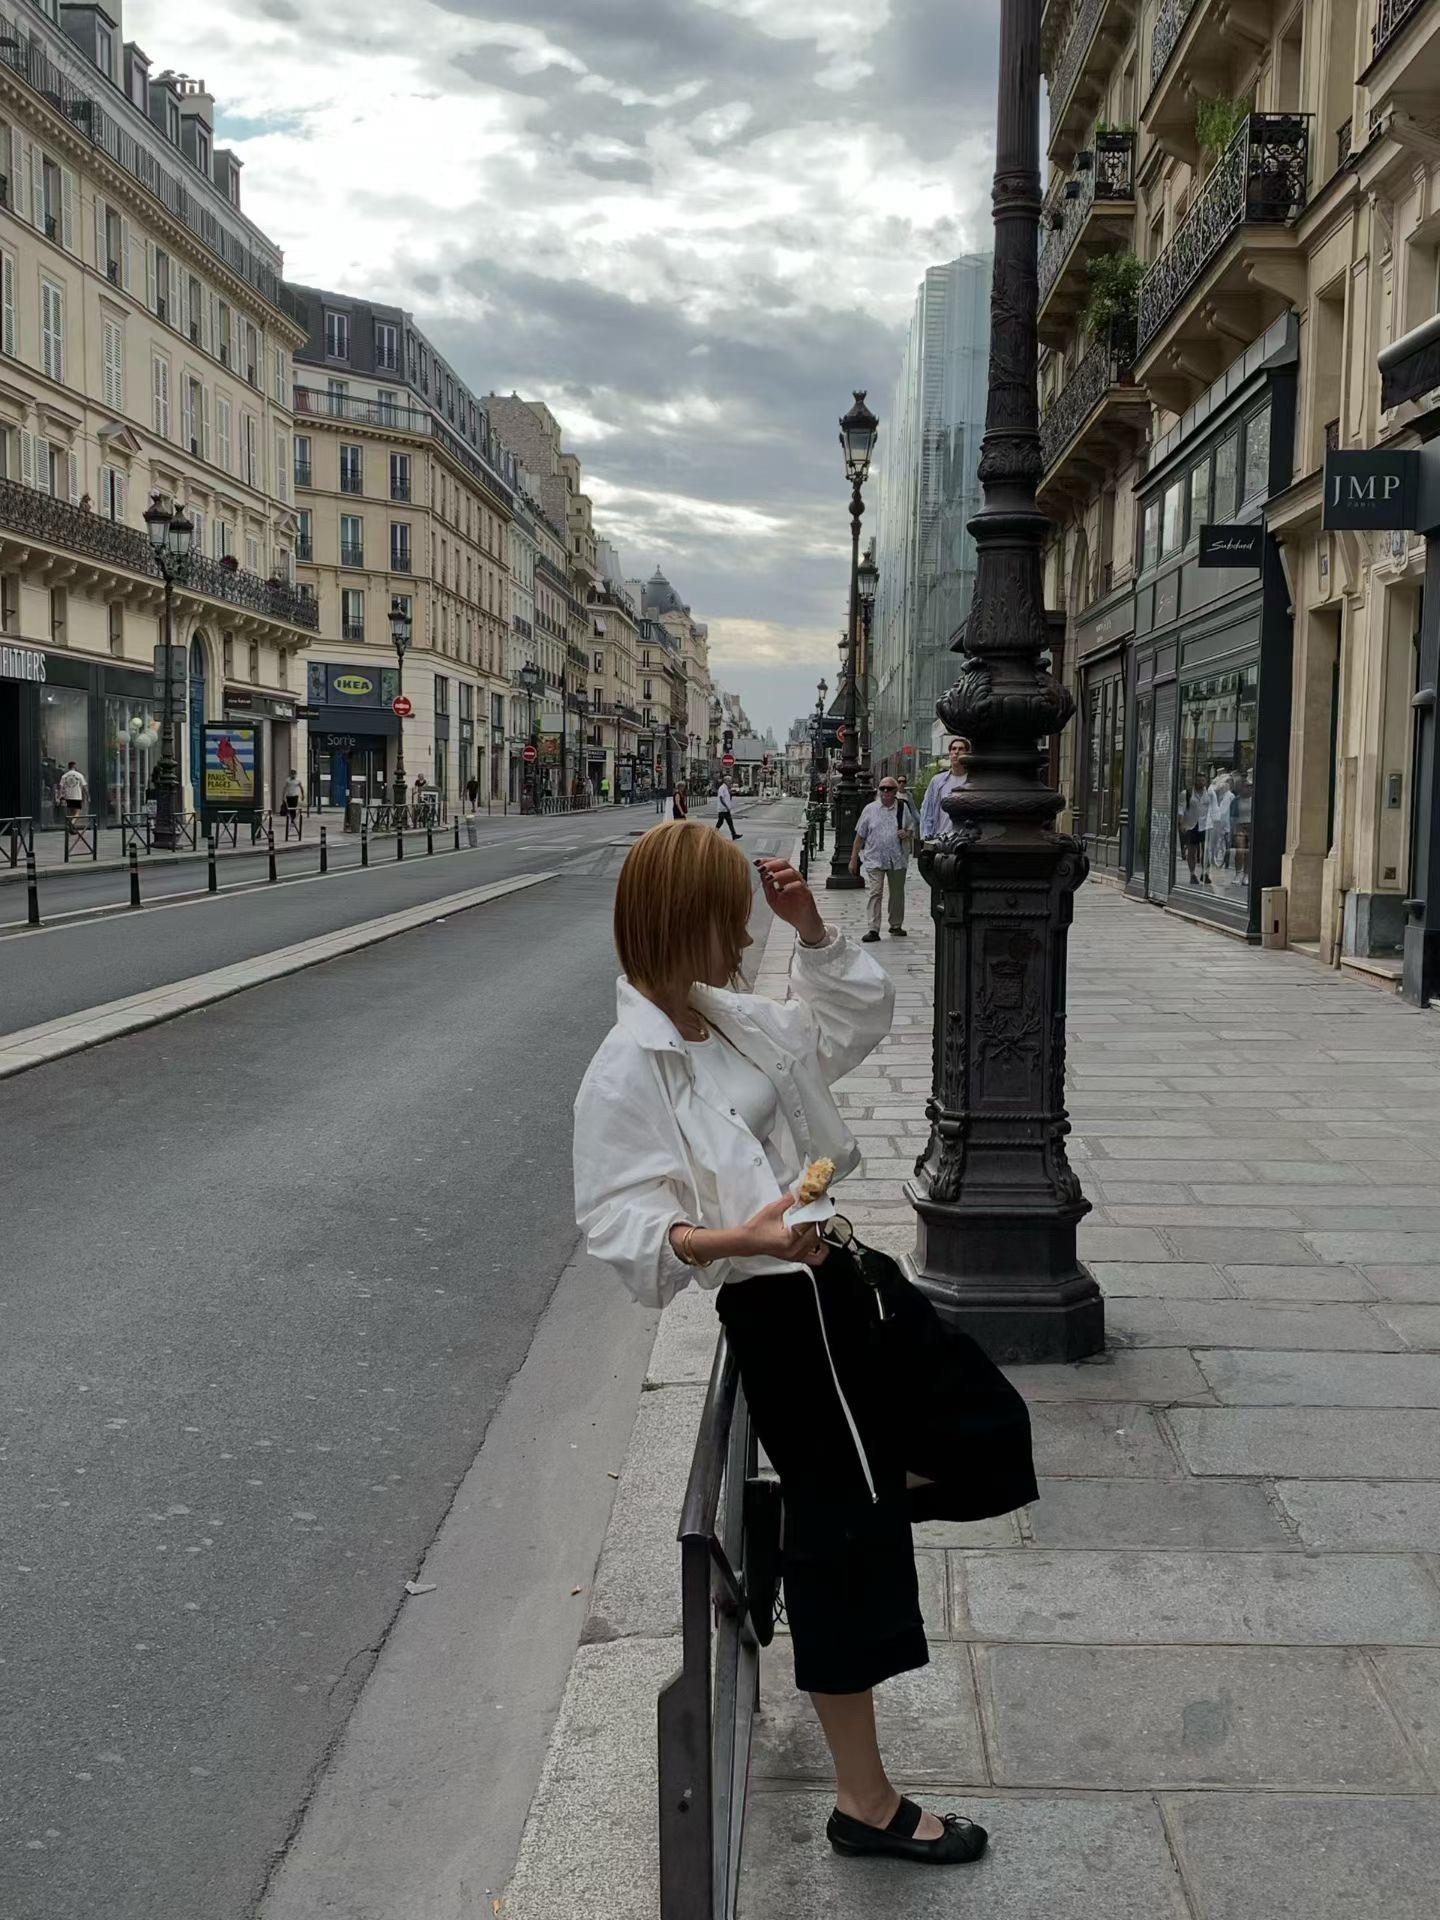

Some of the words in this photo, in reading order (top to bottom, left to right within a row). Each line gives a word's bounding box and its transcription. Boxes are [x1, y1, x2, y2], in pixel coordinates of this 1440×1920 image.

[1332, 475, 1400, 507] JMP
[0, 646, 46, 682] FITTERS
[336, 679, 371, 690] IKEA
